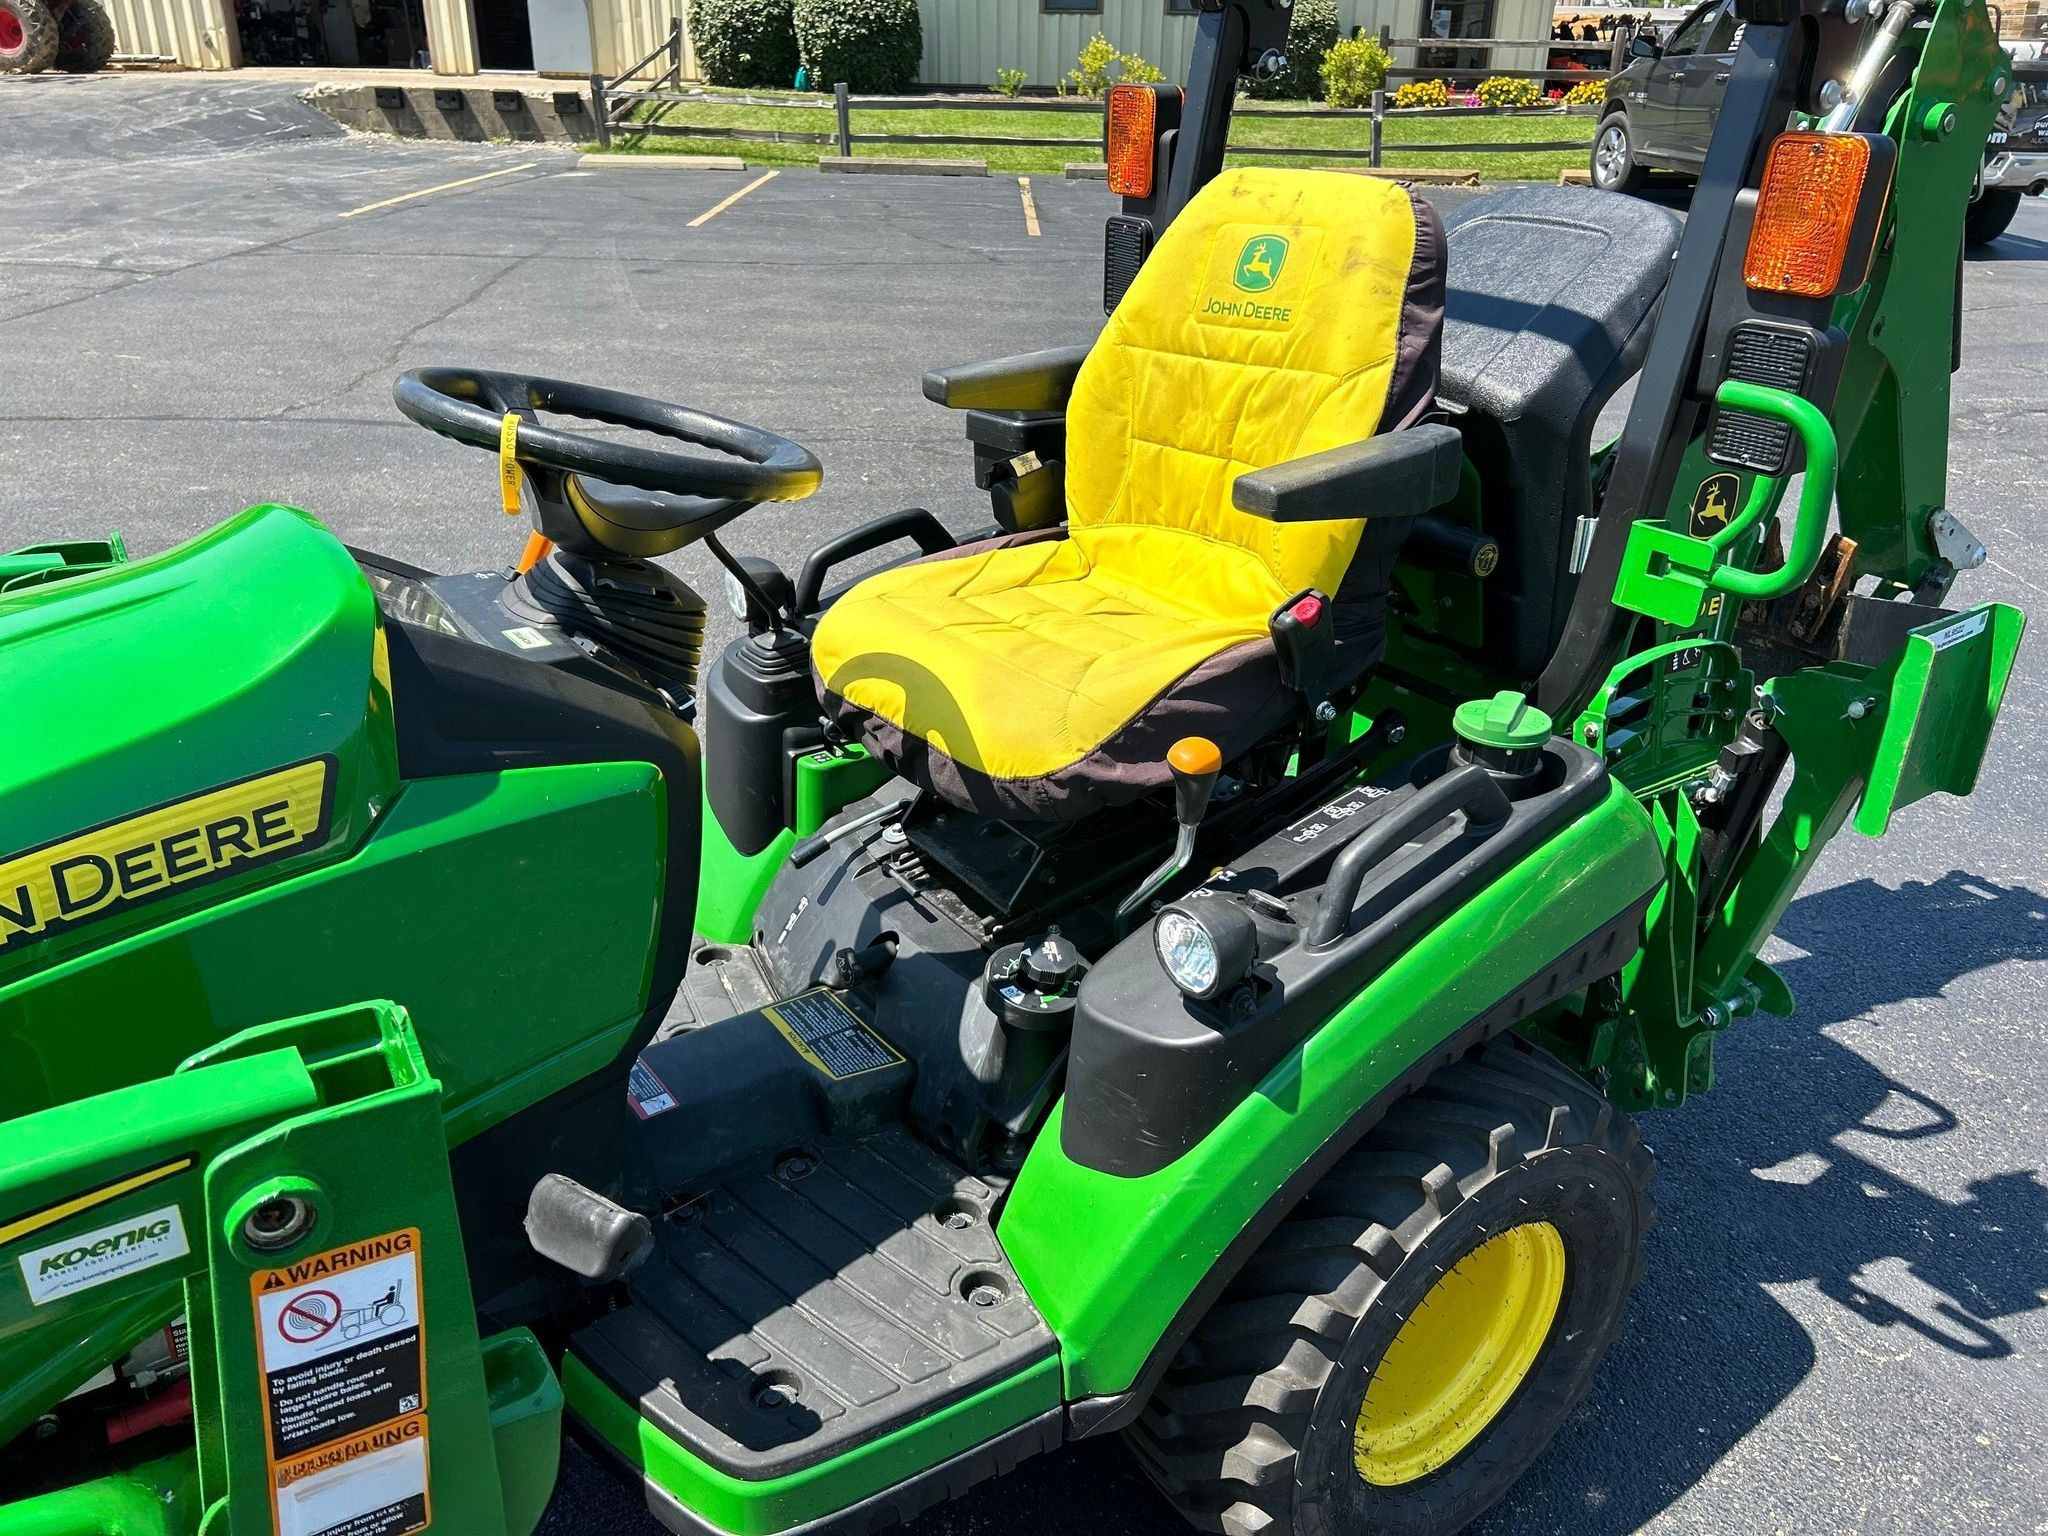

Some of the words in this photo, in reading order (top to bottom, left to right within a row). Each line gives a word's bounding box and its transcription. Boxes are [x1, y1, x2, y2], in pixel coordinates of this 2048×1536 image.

[1202, 297, 1242, 316] JOHN
[1244, 301, 1292, 322] DEERE
[505, 457, 516, 486] POWER
[50, 800, 296, 914] DEERE
[287, 1233, 412, 1283] WARNING
[272, 1377, 286, 1387] To
[286, 1369, 314, 1382] avoid
[315, 1359, 342, 1374] injury
[344, 1354, 355, 1363] or
[356, 1347, 382, 1360] death
[384, 1334, 417, 1351] caused
[272, 1384, 285, 1395] by
[287, 1376, 317, 1391] falling
[279, 1398, 294, 1408] Do
[295, 1392, 311, 1402] not
[313, 1381, 345, 1397] handle
[346, 1371, 374, 1385] round
[375, 1367, 386, 1375] or
[279, 1403, 305, 1415] large
[306, 1391, 338, 1407] square
[280, 1410, 315, 1426] Handle
[316, 1399, 344, 1414] raised
[346, 1391, 372, 1403] loads
[373, 1381, 393, 1393] with
[354, 1513, 375, 1527] from
